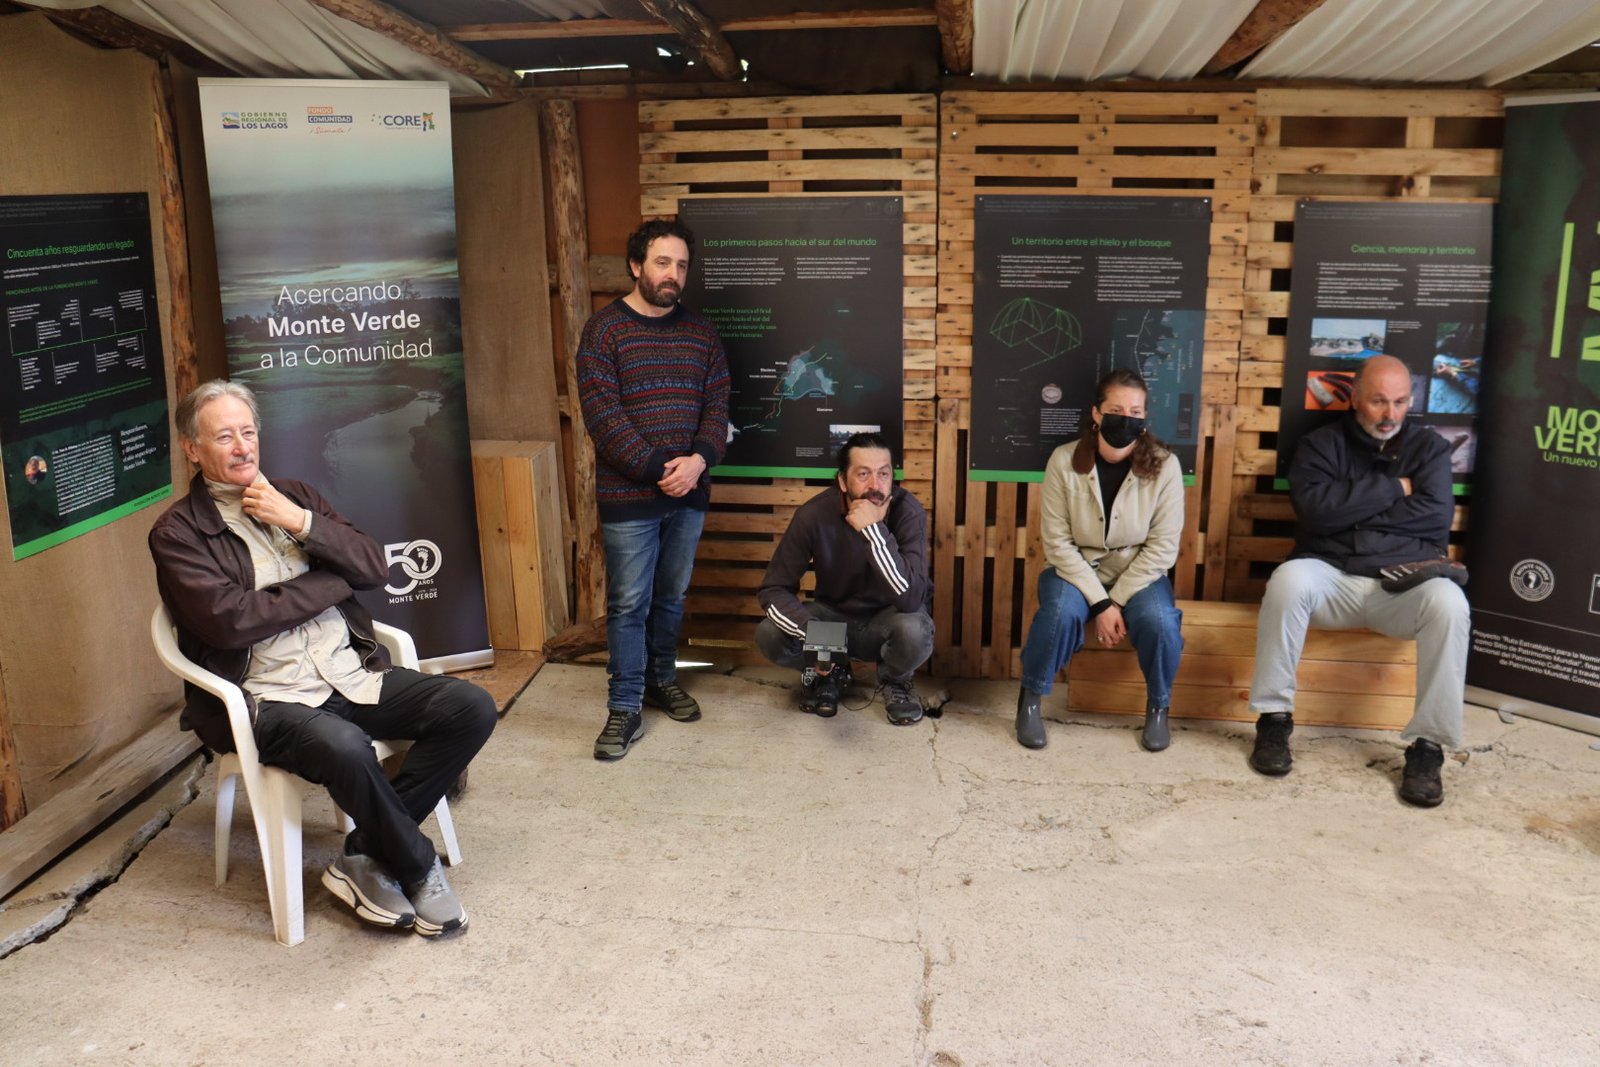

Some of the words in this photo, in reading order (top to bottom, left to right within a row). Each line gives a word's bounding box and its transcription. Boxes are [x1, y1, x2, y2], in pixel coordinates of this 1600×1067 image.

[383, 115, 421, 126] CORE
[7, 247, 44, 259] Cincuenta
[45, 245, 61, 256] años
[62, 242, 106, 255] resguardando
[115, 240, 135, 250] legado
[704, 238, 718, 247] Los
[720, 238, 757, 248] primeros
[758, 240, 783, 248] pasos
[785, 238, 807, 246] hacia
[809, 238, 817, 246] el
[833, 238, 846, 246] del
[848, 238, 877, 246] mundo
[1026, 237, 1064, 246] territorio
[1090, 238, 1098, 246] el
[1099, 238, 1120, 247] hielo
[1129, 239, 1137, 247] el
[1139, 239, 1172, 248] bosque
[1352, 244, 1385, 254] Ciencia,
[1388, 246, 1428, 254] memoria
[1436, 247, 1476, 255] territorio
[278, 281, 401, 305] Acercando
[268, 316, 346, 338] Monte
[350, 310, 421, 331] Verde
[260, 354, 273, 369] a
[280, 348, 298, 368] la
[304, 338, 433, 365] Comunidad
[1534, 425, 1600, 456] VER
[1543, 451, 1559, 462] Un
[1562, 456, 1598, 468] nuevo
[384, 539, 442, 596] 50
[1516, 564, 1534, 576] MONTE
[1535, 565, 1549, 581] VERDE
[389, 595, 413, 604] MONTE
[415, 592, 438, 600] VERDE
[1518, 647, 1552, 660] Patrimonio
[1556, 649, 1571, 657] para
[1509, 661, 1543, 674] Patrimonio
[1512, 654, 1546, 667] Patrimonio
[1547, 662, 1572, 673] Cultural
[1579, 669, 1599, 679] través
